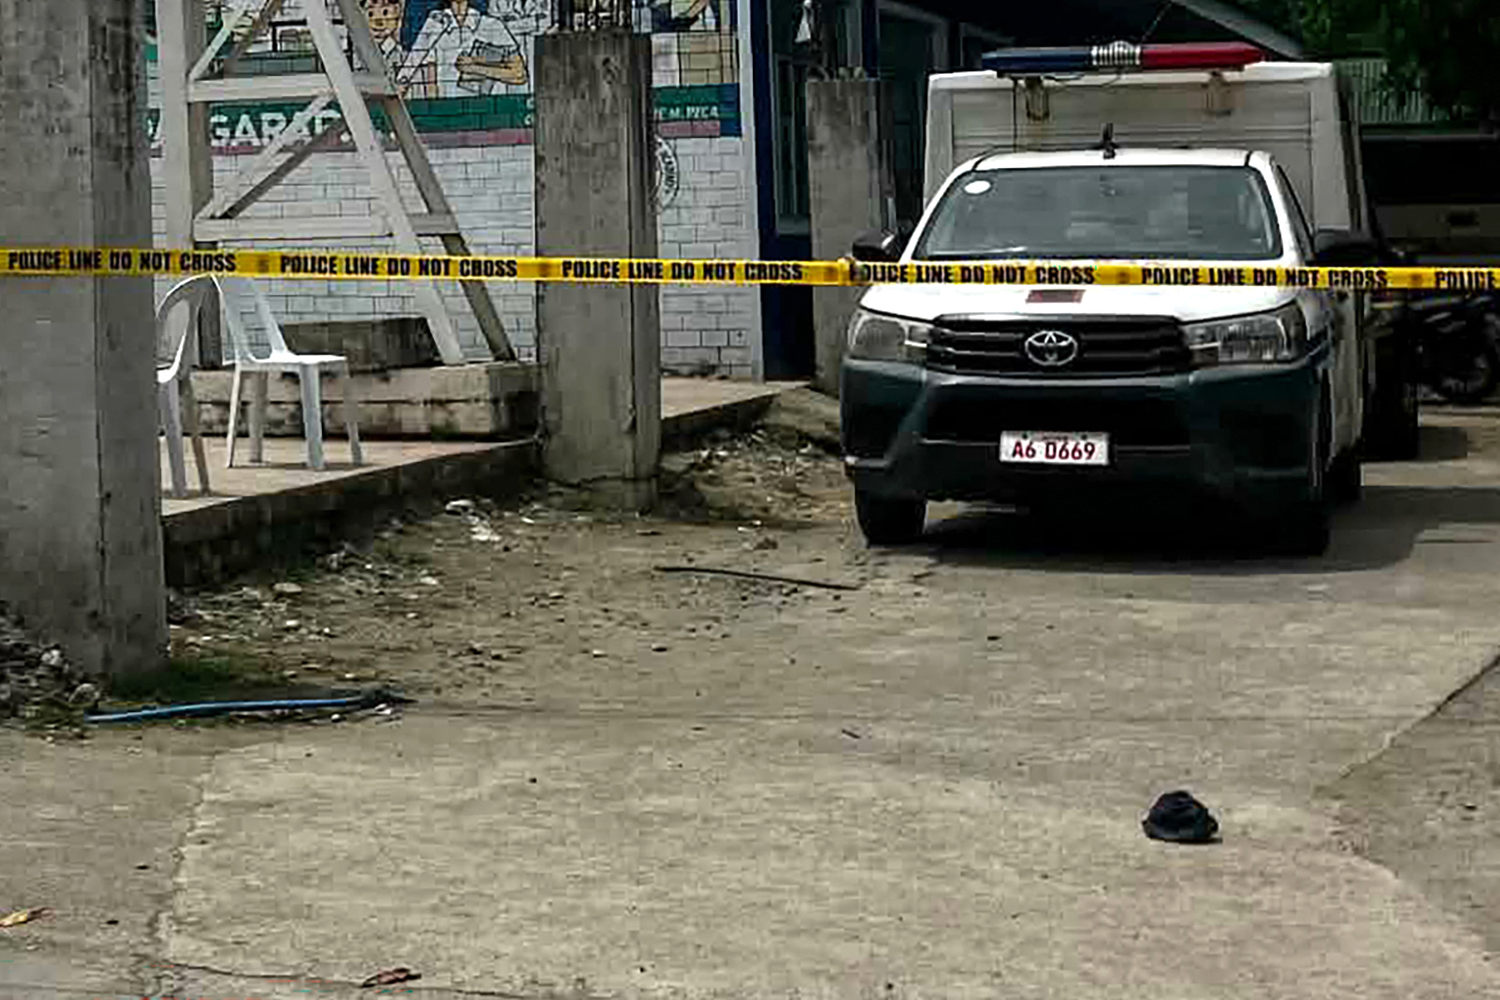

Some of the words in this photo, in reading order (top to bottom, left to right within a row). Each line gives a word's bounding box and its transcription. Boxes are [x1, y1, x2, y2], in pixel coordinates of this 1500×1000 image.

[8, 252, 62, 270] POLICE
[69, 251, 102, 269] LINE
[109, 251, 132, 270] DO
[139, 252, 171, 270] NOT
[180, 252, 236, 272] CROSS
[280, 256, 337, 274] POLICE
[345, 257, 379, 274] LINE
[387, 257, 410, 275] DO
[418, 258, 451, 276] NOT
[459, 259, 517, 277] CROSS
[562, 261, 620, 279] POLICE
[628, 262, 663, 279] LINE
[671, 262, 695, 280] DO
[703, 263, 736, 280] NOT
[744, 263, 803, 281] CROSS
[916, 265, 954, 283] LINE
[960, 266, 985, 283] DO
[993, 266, 1026, 284] NOT
[1035, 266, 1095, 284] CROSS
[1142, 267, 1200, 285] POLICE
[1209, 268, 1247, 285] LINE
[1253, 269, 1277, 285] DO
[1285, 269, 1320, 286] NOT
[1328, 270, 1387, 287] CROSS
[1434, 271, 1496, 287] POLICE
[1012, 441, 1036, 459] A6
[1045, 441, 1096, 460] 0669
